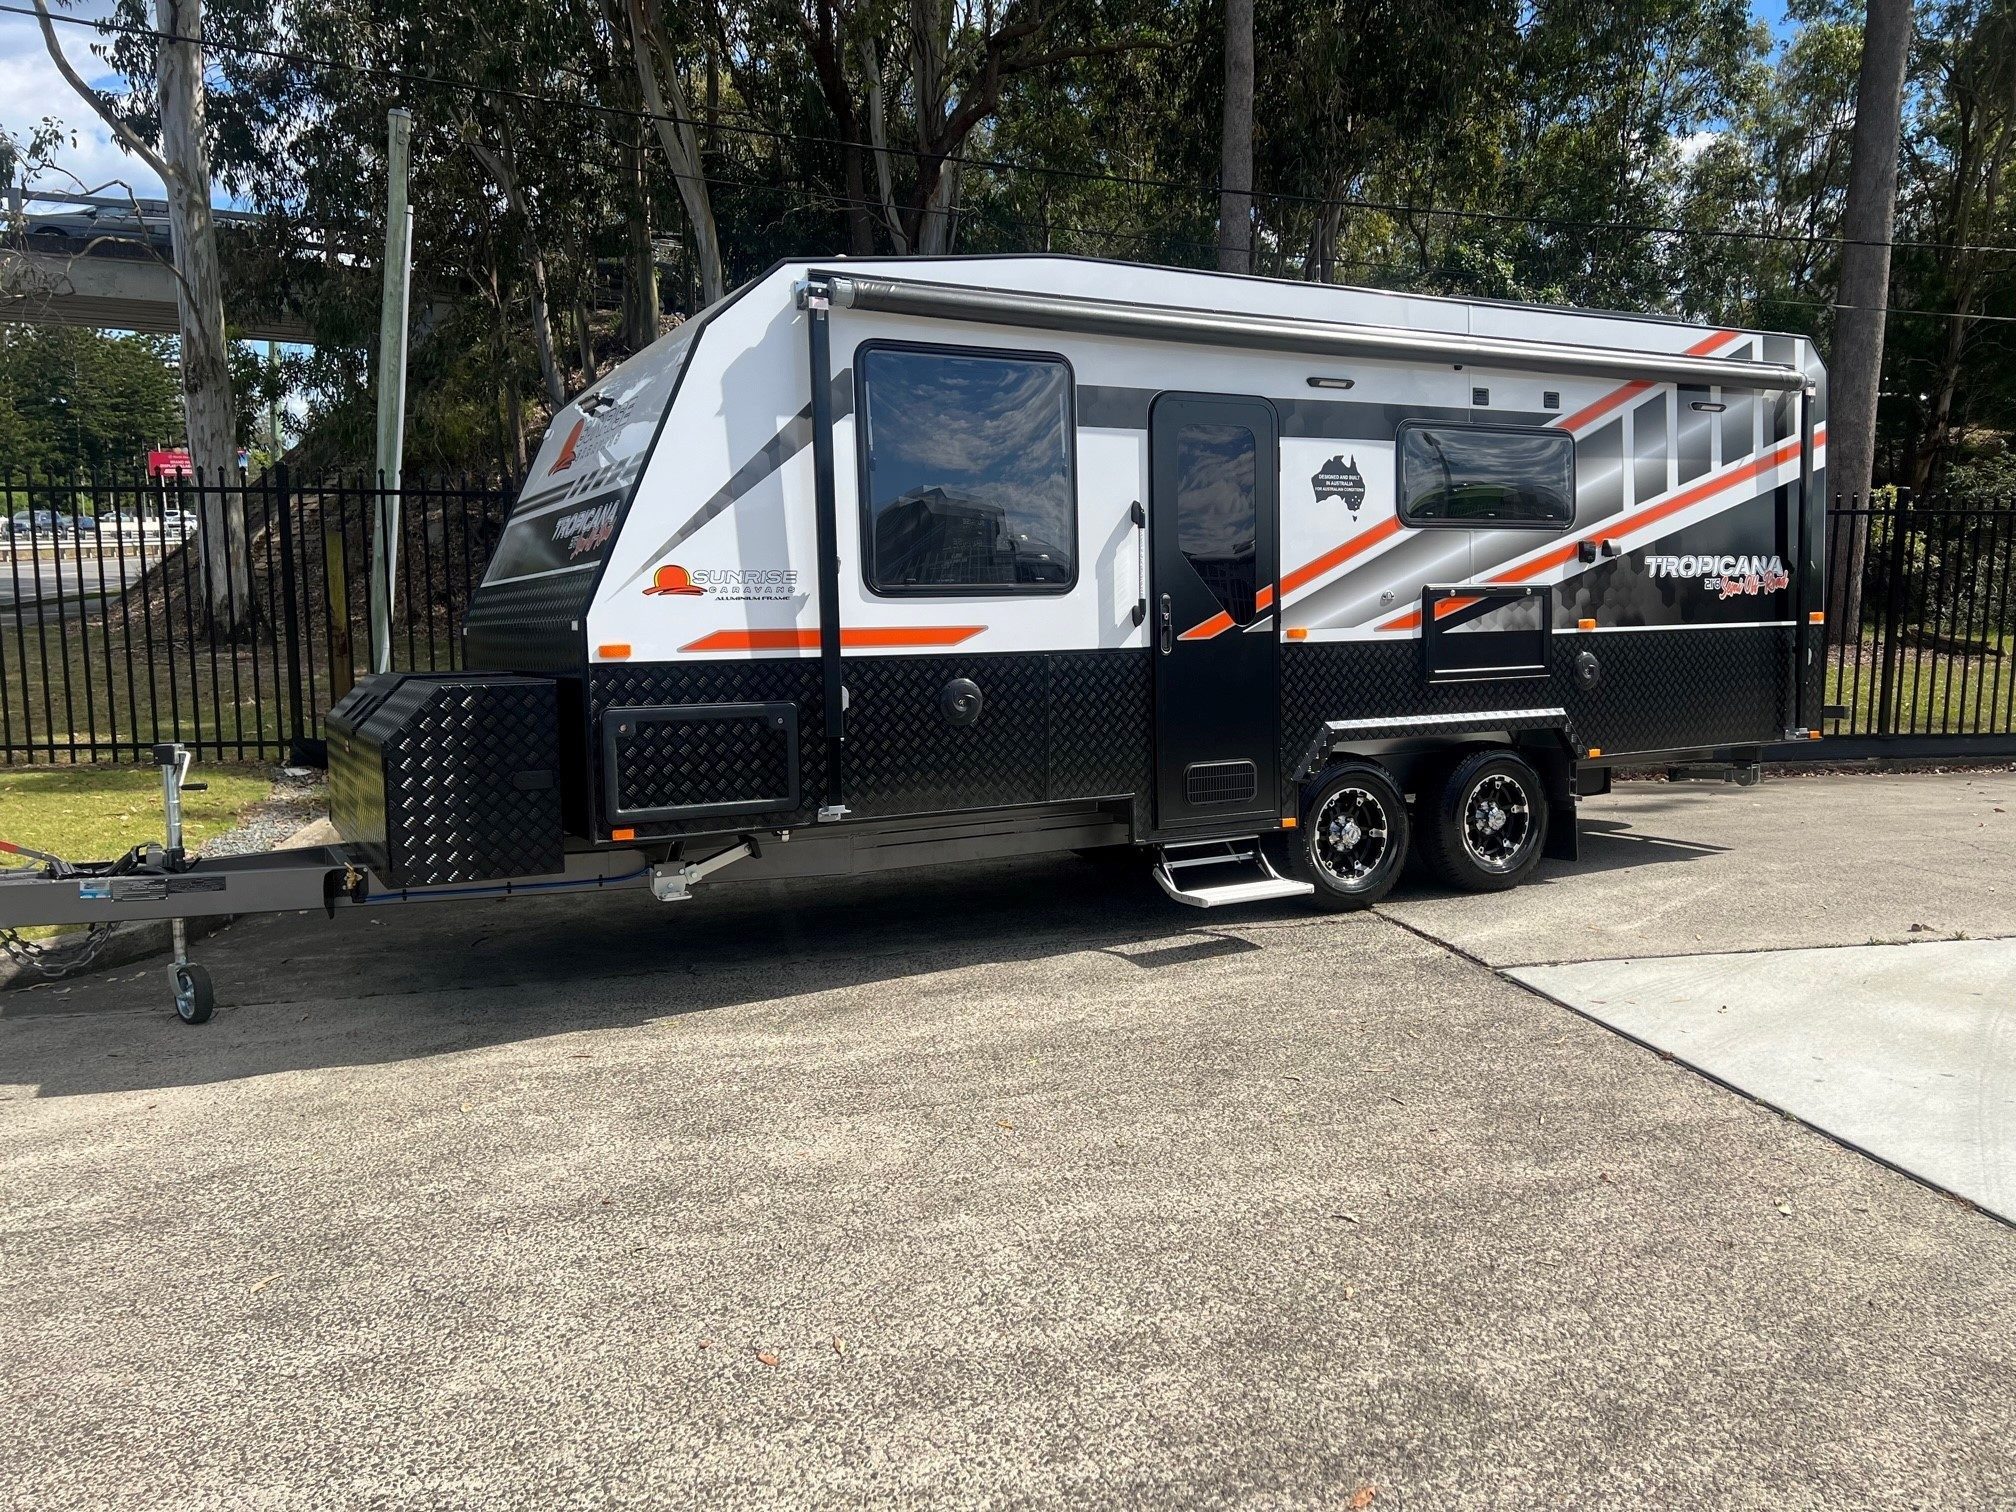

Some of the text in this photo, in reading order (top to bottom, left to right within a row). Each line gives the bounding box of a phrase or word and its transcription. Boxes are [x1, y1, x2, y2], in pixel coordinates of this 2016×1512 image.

[551, 499, 620, 541] TROPICANA
[693, 570, 798, 584] SUNRISE
[1644, 555, 1784, 578] TROPICANA
[1719, 576, 1744, 600] Semi
